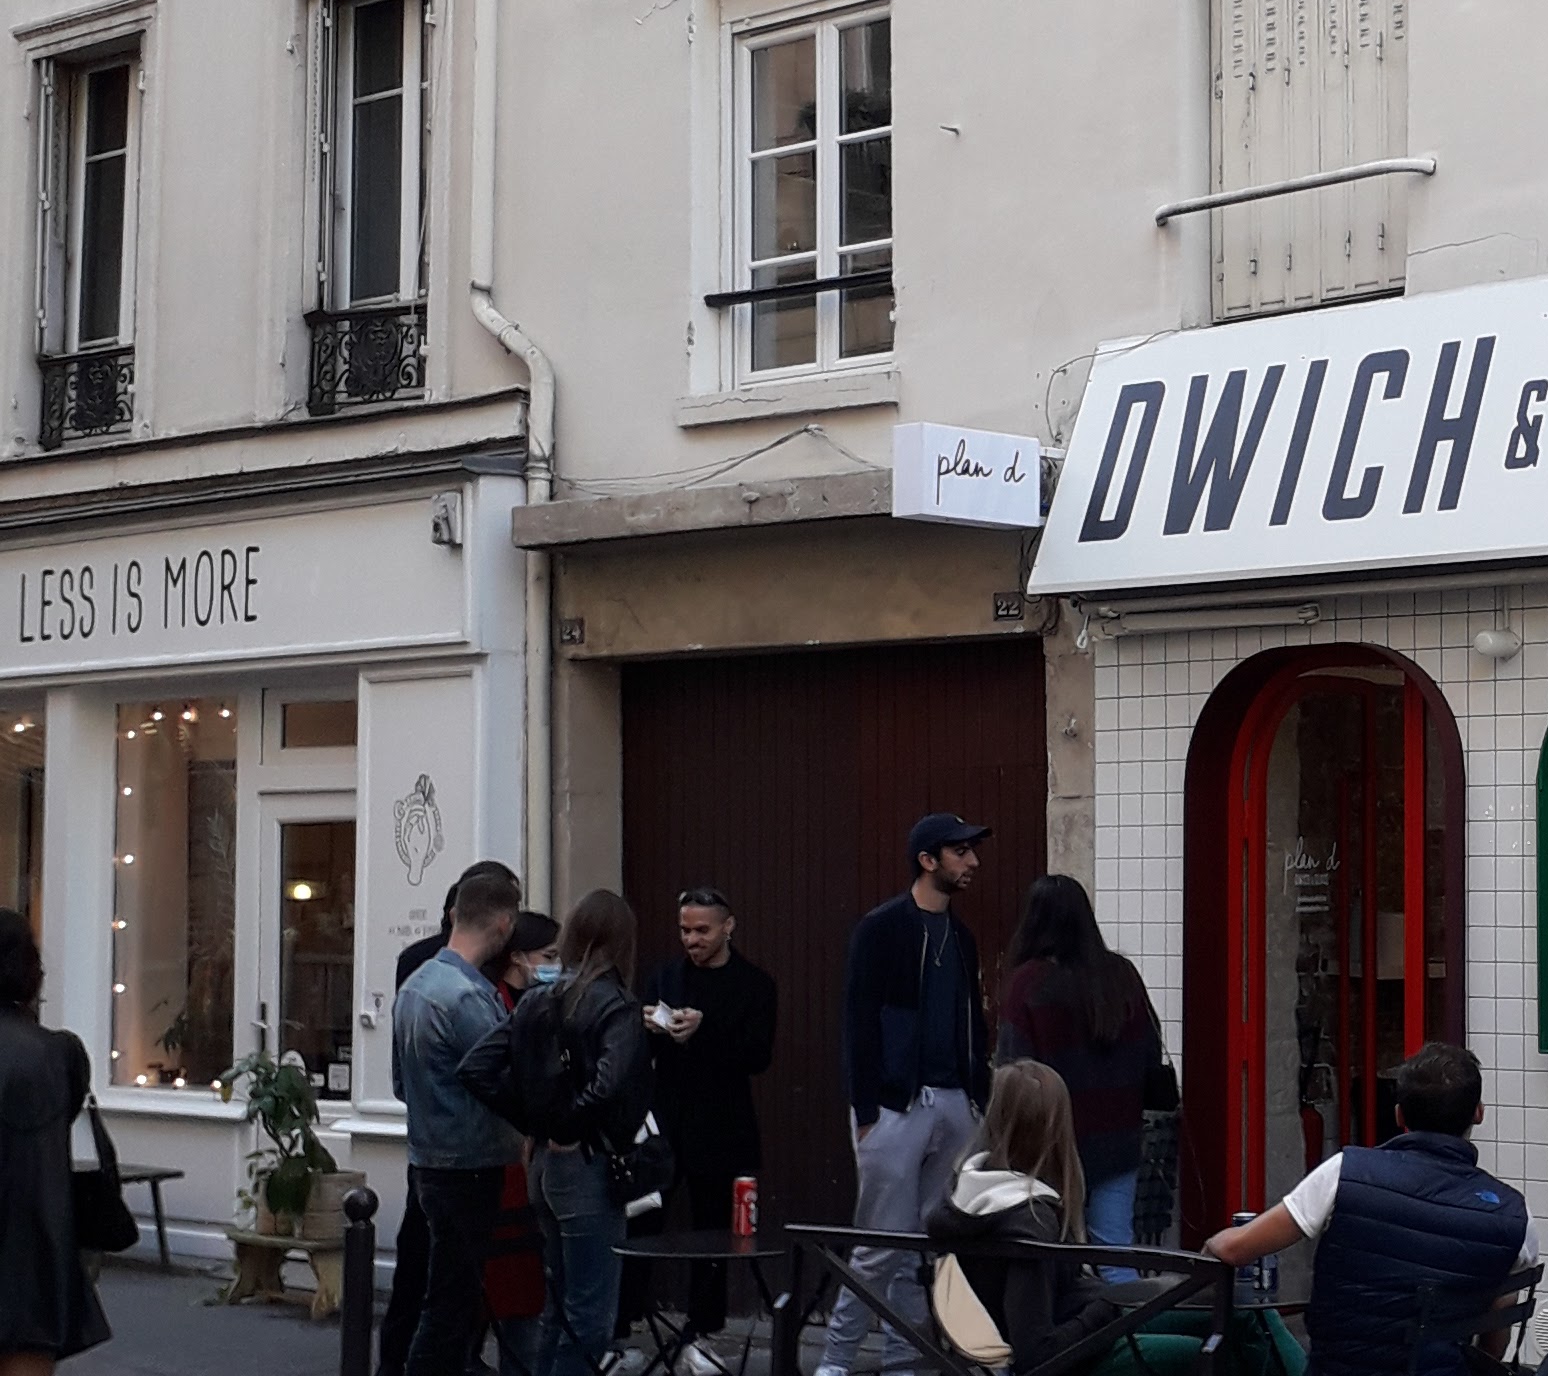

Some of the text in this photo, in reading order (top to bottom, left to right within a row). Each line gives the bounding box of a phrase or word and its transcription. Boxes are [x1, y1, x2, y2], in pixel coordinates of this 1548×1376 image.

[936, 438, 1027, 506] plan d
[1077, 335, 1497, 544] DWICH
[1504, 377, 1547, 470] &
[19, 546, 260, 643] LESS IS MORE
[996, 598, 1020, 616] 22
[1283, 835, 1320, 895] plan
